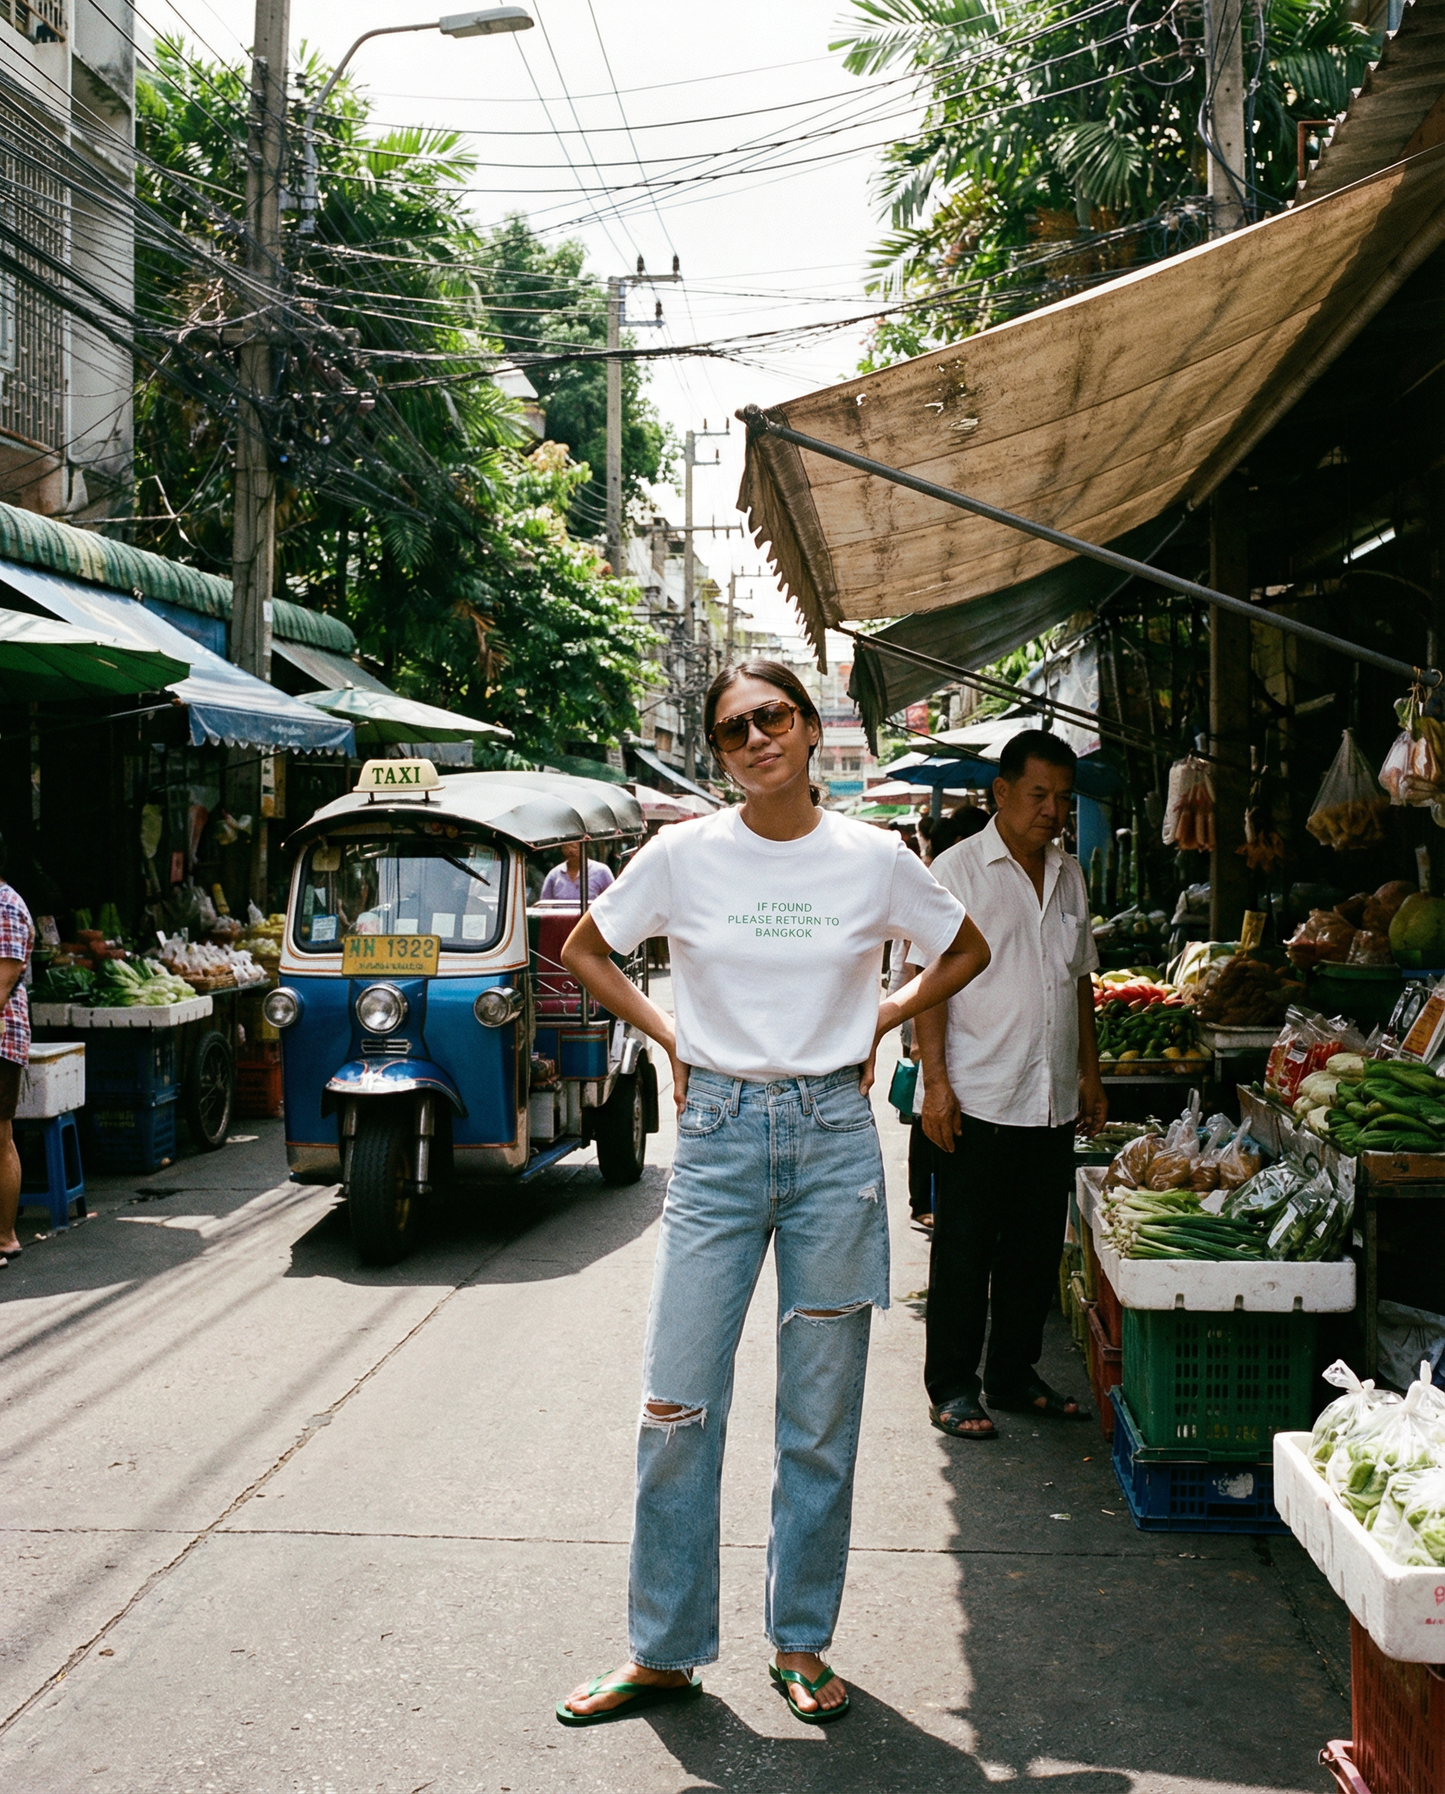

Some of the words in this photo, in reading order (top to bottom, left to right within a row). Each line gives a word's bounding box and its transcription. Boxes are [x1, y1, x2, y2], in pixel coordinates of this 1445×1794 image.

[371, 766, 421, 785] TAXI
[757, 902, 768, 912] IF
[771, 902, 813, 913] FOUND
[727, 914, 773, 925] PLEASE
[775, 915, 822, 926] RETURN
[824, 917, 840, 927] TO
[755, 927, 813, 938] BANGKOK
[387, 938, 435, 959] 1322
